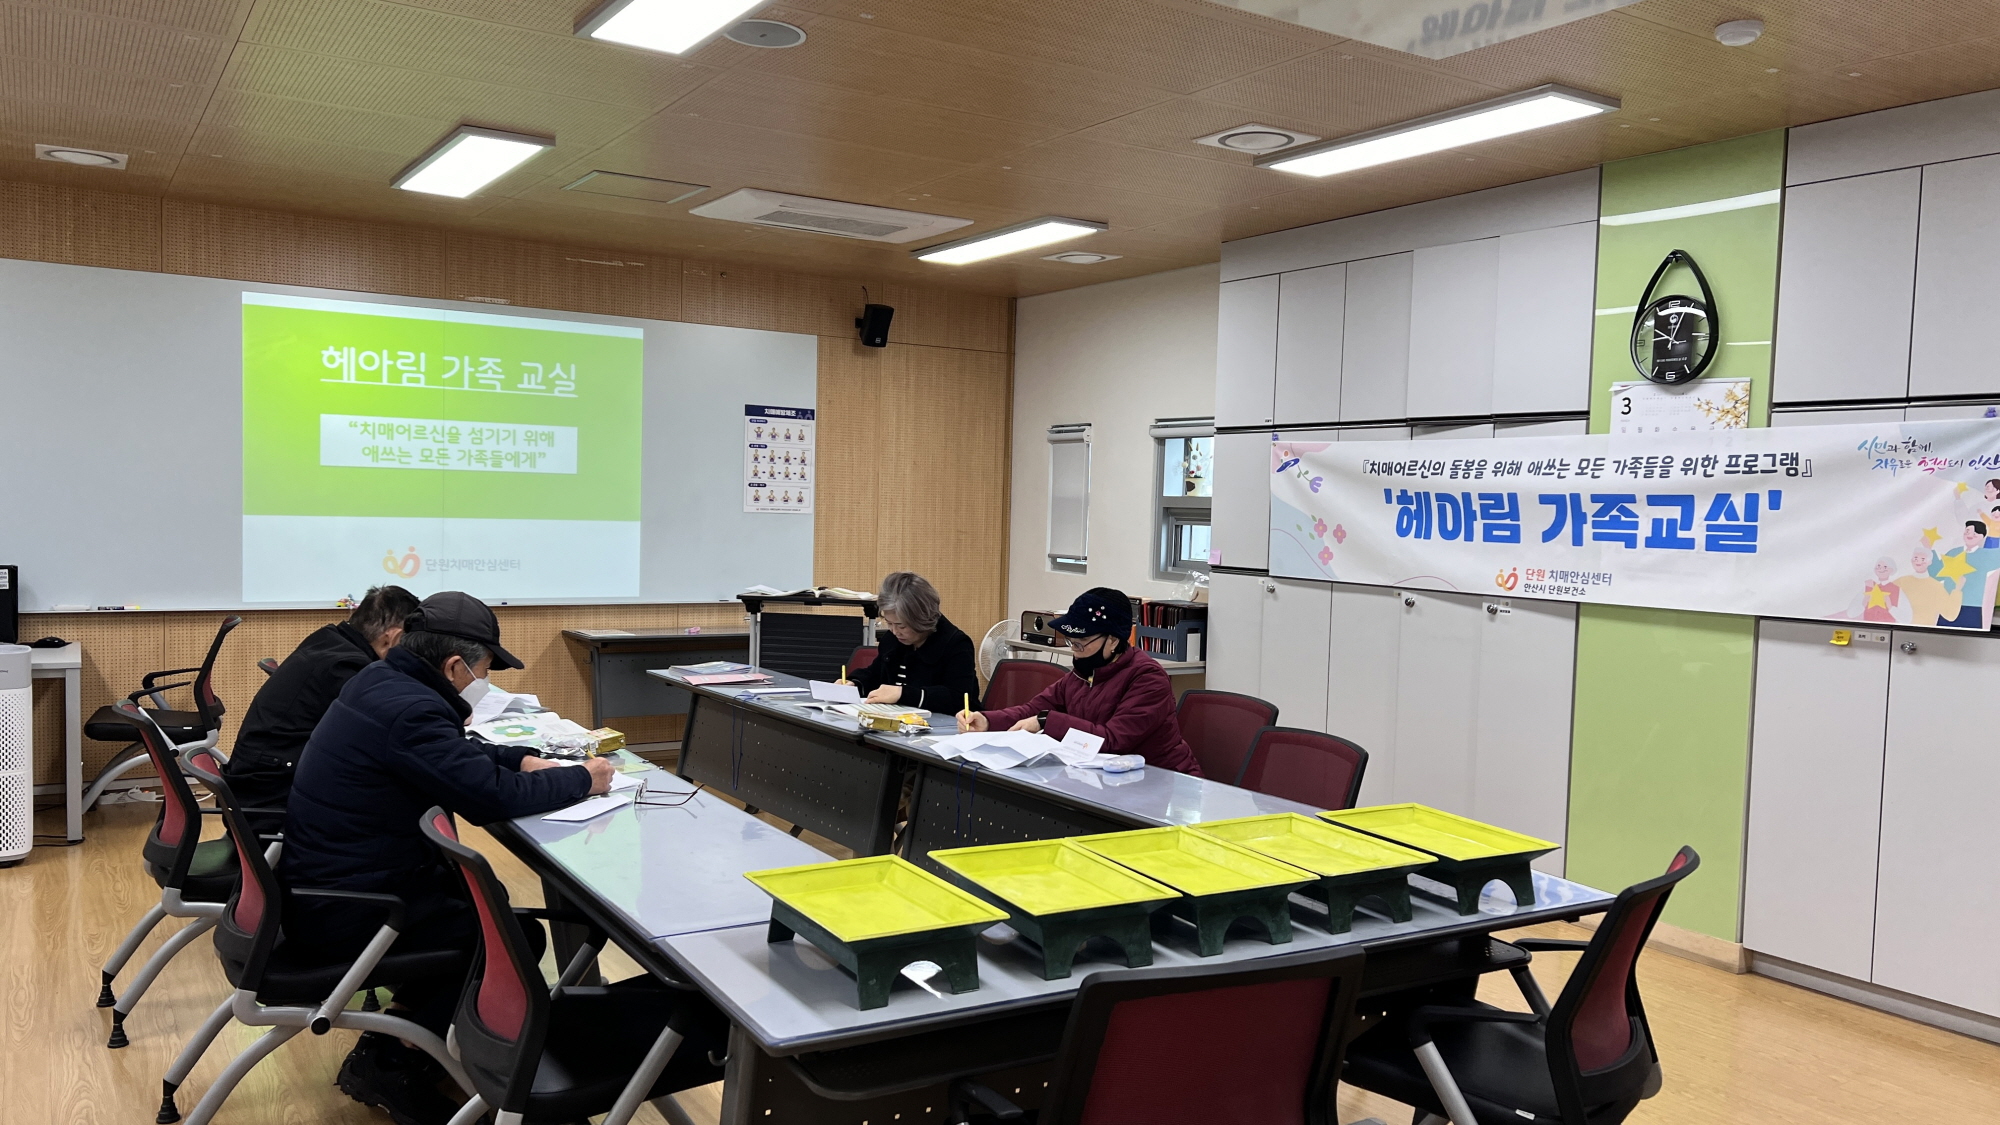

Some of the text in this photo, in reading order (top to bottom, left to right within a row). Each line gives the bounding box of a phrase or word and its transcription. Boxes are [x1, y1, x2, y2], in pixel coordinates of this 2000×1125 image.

[321, 345, 576, 397] 헤아림 가족 교실
[1620, 397, 1632, 415] 3
[348, 420, 555, 447] “치매어르신을 섬기기 위해
[361, 446, 546, 469] 애쓰는 모든 가족들에게”
[1857, 435, 1901, 460] 시민과
[1362, 452, 1813, 479] 『치매어르신의 돌봄을 위해 애쓰는 모든 가족들을 위한 프로그램』
[1871, 453, 2000, 477] 자유로운 혁신도시 안산
[1383, 488, 1521, 544] '헤아림
[425, 558, 521, 572] 단원치매안심센터
[1525, 568, 1613, 586] 단원 치매안심센터
[1524, 583, 1587, 597] 안산시 단원보건소
